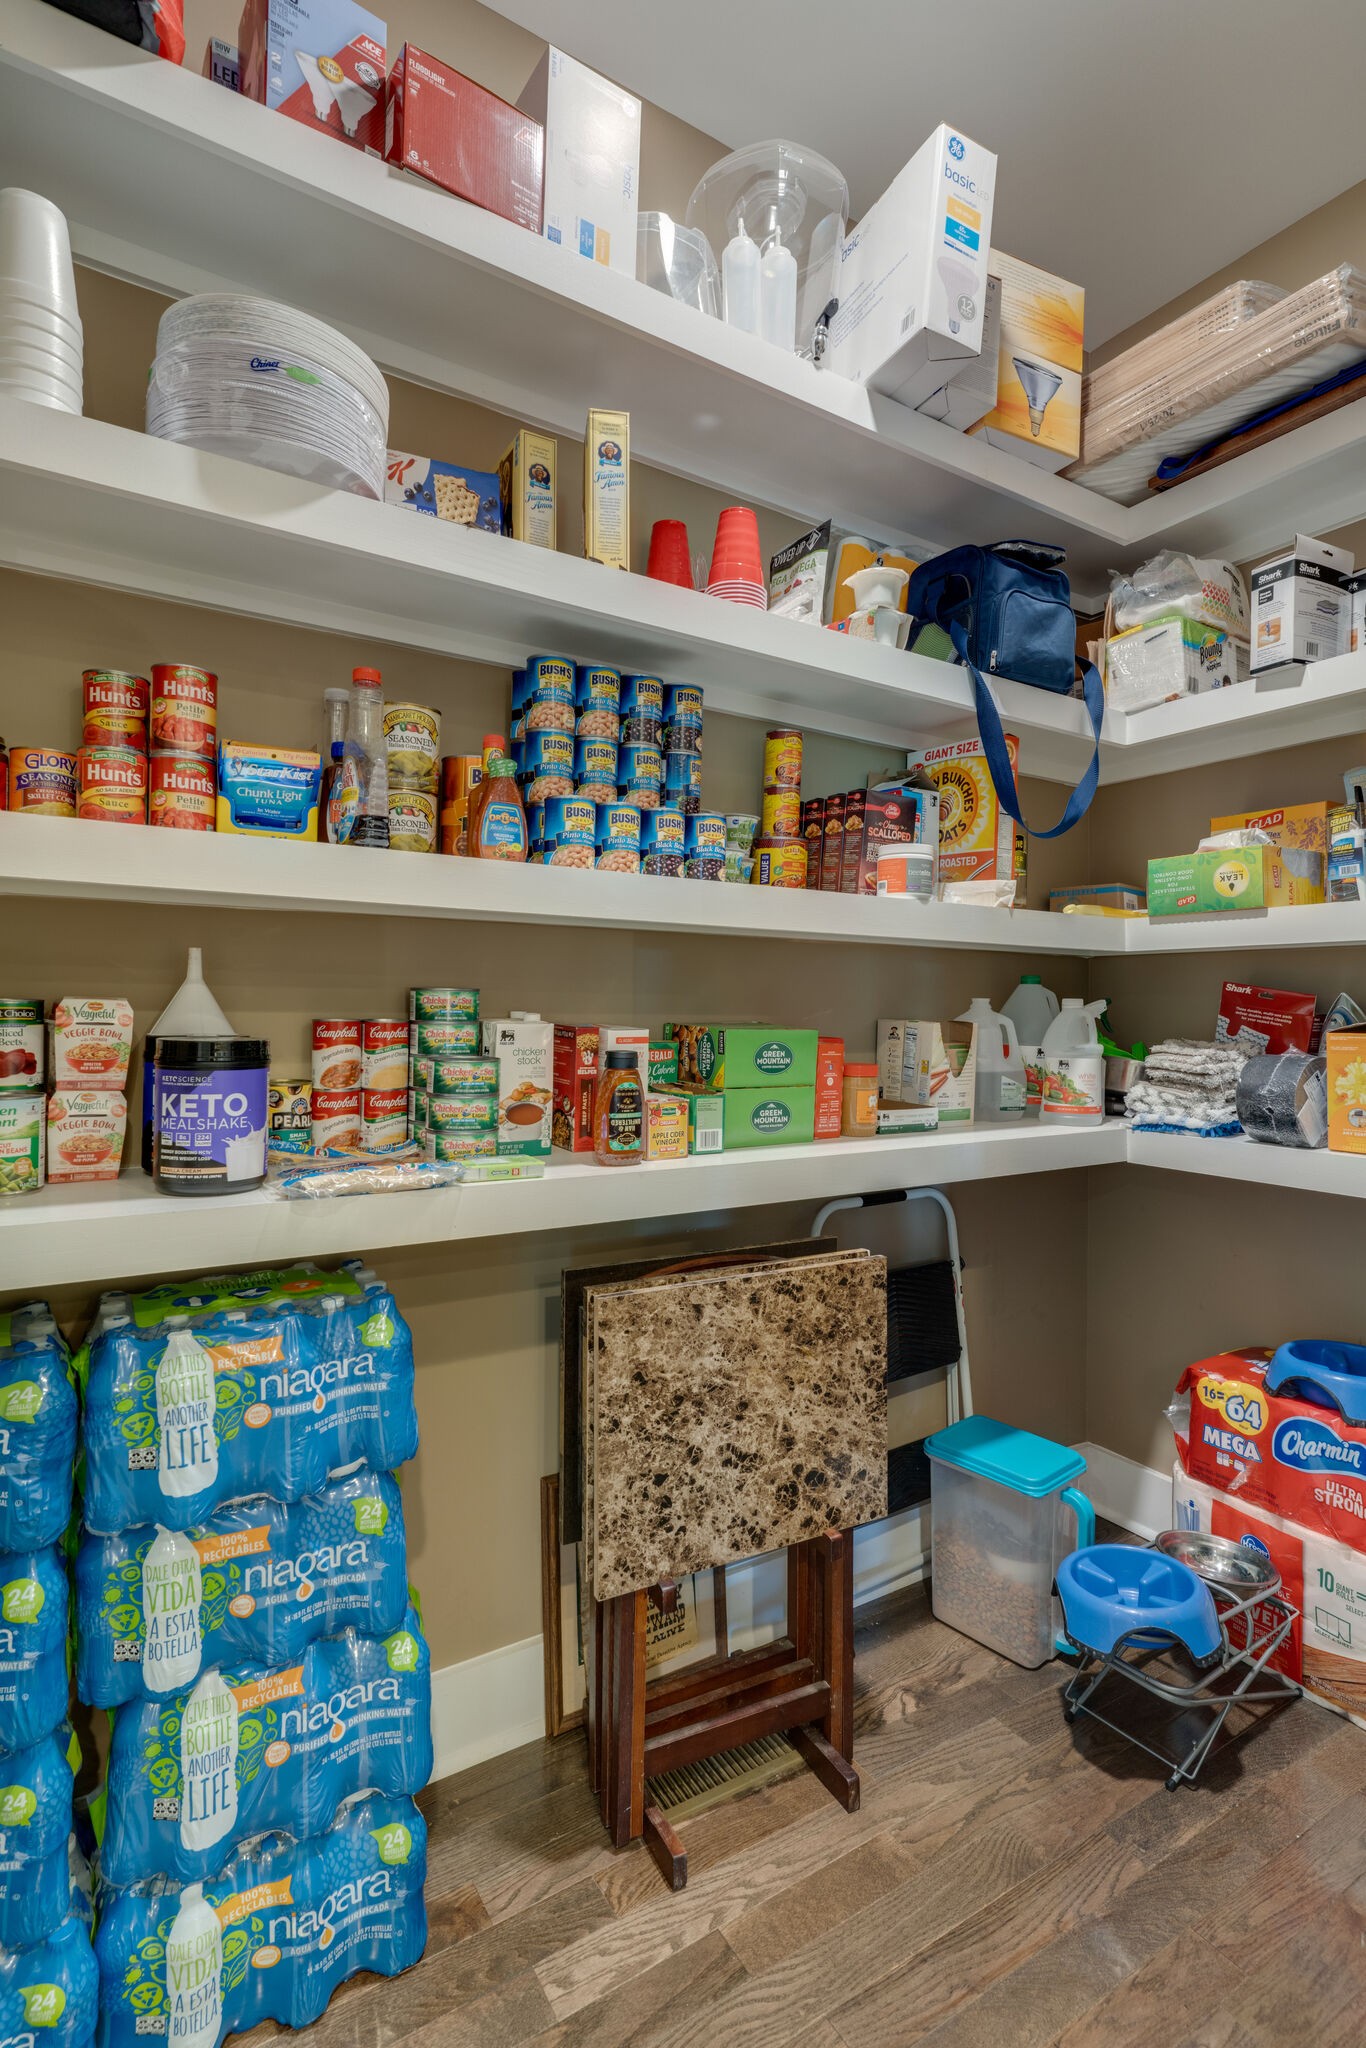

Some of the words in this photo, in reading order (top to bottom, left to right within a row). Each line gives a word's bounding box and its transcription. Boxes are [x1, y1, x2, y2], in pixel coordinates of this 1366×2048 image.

[362, 39, 382, 57] ACE
[213, 62, 239, 86] LED
[409, 58, 446, 84] FLOODLIGHT
[944, 162, 976, 194] basic
[1294, 318, 1341, 349] Filtrete
[387, 458, 416, 486] K
[594, 471, 625, 483] Famous
[600, 478, 625, 490] Amos
[525, 492, 553, 503] Famous
[531, 500, 553, 510] Amos
[1258, 569, 1282, 583] Shark
[1299, 562, 1320, 576] Shark
[1200, 642, 1223, 667] Bounty
[540, 664, 572, 680] BUSH'S
[591, 674, 620, 691] BUSH'S
[89, 686, 142, 708] Hunt's
[163, 681, 215, 704] Hunt's
[553, 689, 573, 700] Beans
[176, 702, 206, 716] Petite
[99, 718, 128, 729] Sauce
[387, 734, 433, 747] SEASONED
[543, 739, 573, 755] BUSH'S
[586, 747, 616, 763] BUSH'S
[925, 745, 954, 761] GIANT
[956, 740, 979, 755] SIZE
[25, 753, 77, 776] GLORY
[247, 762, 314, 782] StarKist
[540, 763, 558, 771] Pinto
[87, 764, 143, 787] Hunt's
[583, 770, 601, 779] Pinto
[119, 787, 137, 795] ADDED
[163, 772, 214, 795] Hunt's
[941, 771, 974, 813] BUNCHES
[27, 793, 55, 802] SKILLET
[99, 797, 129, 809] Sauce
[176, 795, 205, 807] Petite
[236, 787, 275, 800] Chunk
[275, 787, 303, 803] Light
[255, 798, 283, 806] TUNA
[566, 805, 596, 821] BUSH'S
[611, 812, 640, 828] BUSH'S
[1247, 812, 1283, 829] GLAD
[699, 822, 726, 836] BUSH'S
[868, 826, 911, 842] SCALLOPED
[655, 841, 672, 849] Black
[760, 858, 770, 884] VALUE
[940, 856, 978, 869] ROASTED
[1152, 870, 1179, 878] CONTROL
[1219, 873, 1244, 883] LEAK
[1177, 895, 1197, 907] GLAD
[1225, 983, 1253, 995] Shark
[73, 1001, 116, 1021] Veggieful
[63, 1027, 97, 1040] VEGGIE
[99, 1028, 123, 1041] BOWL
[316, 1025, 358, 1040] Campbell's
[321, 1050, 341, 1062] Vegetable
[512, 1047, 547, 1057] chicken
[516, 1056, 542, 1065] stock
[762, 1050, 786, 1058] GREEN
[756, 1057, 791, 1065] MOUNTAIN
[442, 1068, 474, 1077] Chicken
[652, 1065, 676, 1077] Calorie
[66, 1092, 110, 1112] Veggieful
[161, 1092, 248, 1118] KETO
[317, 1096, 359, 1109] Campbell's
[753, 1116, 789, 1124] MOUNTAIN
[759, 1109, 783, 1117] GREEN
[56, 1120, 90, 1132] VEGGIE
[92, 1120, 117, 1132] BOWL
[161, 1116, 248, 1130] MEALSHAKE
[652, 1132, 668, 1140] APPLE
[669, 1131, 685, 1139] CIDER
[655, 1138, 680, 1146] VINEGAR
[5, 1146, 29, 1154] BEANS
[367, 1319, 387, 1335] 24
[232, 1342, 261, 1356] 100%
[160, 1358, 183, 1378] GIVE
[184, 1352, 207, 1373] THIS
[217, 1351, 277, 1370] RECYCLABLE
[260, 1352, 376, 1402] niagara
[7, 1386, 37, 1405] 24
[161, 1375, 210, 1407] BOTTLE
[327, 1383, 362, 1401] DRINKING
[363, 1381, 388, 1392] WATER
[164, 1401, 209, 1427] ANOTHER
[274, 1403, 312, 1417] PURIFIED
[1225, 1395, 1263, 1430] 64
[166, 1423, 212, 1471] LIFE
[1203, 1424, 1263, 1463] MEGA
[1281, 1431, 1361, 1469] Charmin
[1325, 1480, 1363, 1505] ULTRA
[359, 1503, 382, 1520] 24
[219, 1535, 248, 1547] 100%
[1242, 1539, 1270, 1560] Kroger
[203, 1541, 265, 1563] RECICLABLES
[145, 1564, 168, 1584] DALE
[171, 1557, 196, 1578] OTRA
[245, 1540, 369, 1592] niagara
[322, 1572, 367, 1586] PURIFICADA
[1316, 1567, 1335, 1593] 10
[8, 1585, 36, 1607] 24
[146, 1575, 197, 1615] VIDA
[1335, 1582, 1354, 1596] GIANT
[1335, 1589, 1356, 1605] ROLLS
[264, 1593, 288, 1606] AGUA
[149, 1616, 159, 1640] A
[166, 1609, 196, 1637] ESTA
[651, 1622, 686, 1645] ALIVE
[148, 1632, 199, 1662] BOTELLA
[391, 1637, 412, 1655] 24
[256, 1676, 284, 1693] 100%
[241, 1682, 299, 1710] RECYCLABLE
[185, 1701, 210, 1726] GIVE
[210, 1692, 232, 1718] THIS
[280, 1677, 400, 1740] niagara
[348, 1709, 386, 1728] DRINKING
[387, 1706, 411, 1719] WATER
[186, 1715, 233, 1757] BOTTLE
[293, 1734, 330, 1755] PURIFIED
[187, 1745, 232, 1778] ANOTHER
[3, 1791, 27, 1812] 24
[189, 1767, 231, 1823] LIFE
[383, 1828, 405, 1849] 24
[240, 1885, 272, 1905] 100%
[221, 1892, 289, 1925] RECICLABLES
[268, 1870, 392, 1944] niagara
[342, 1901, 390, 1927] PURIFICADA
[168, 1940, 193, 1963] DALE
[195, 1926, 219, 1956] OTRA
[290, 1945, 312, 1959] AGUA
[169, 1946, 218, 1991] VIDA
[31, 1988, 57, 2013] 24
[175, 1993, 184, 2013] A
[189, 1976, 217, 2012] ESTA
[173, 1997, 218, 2038] BOTELLA
